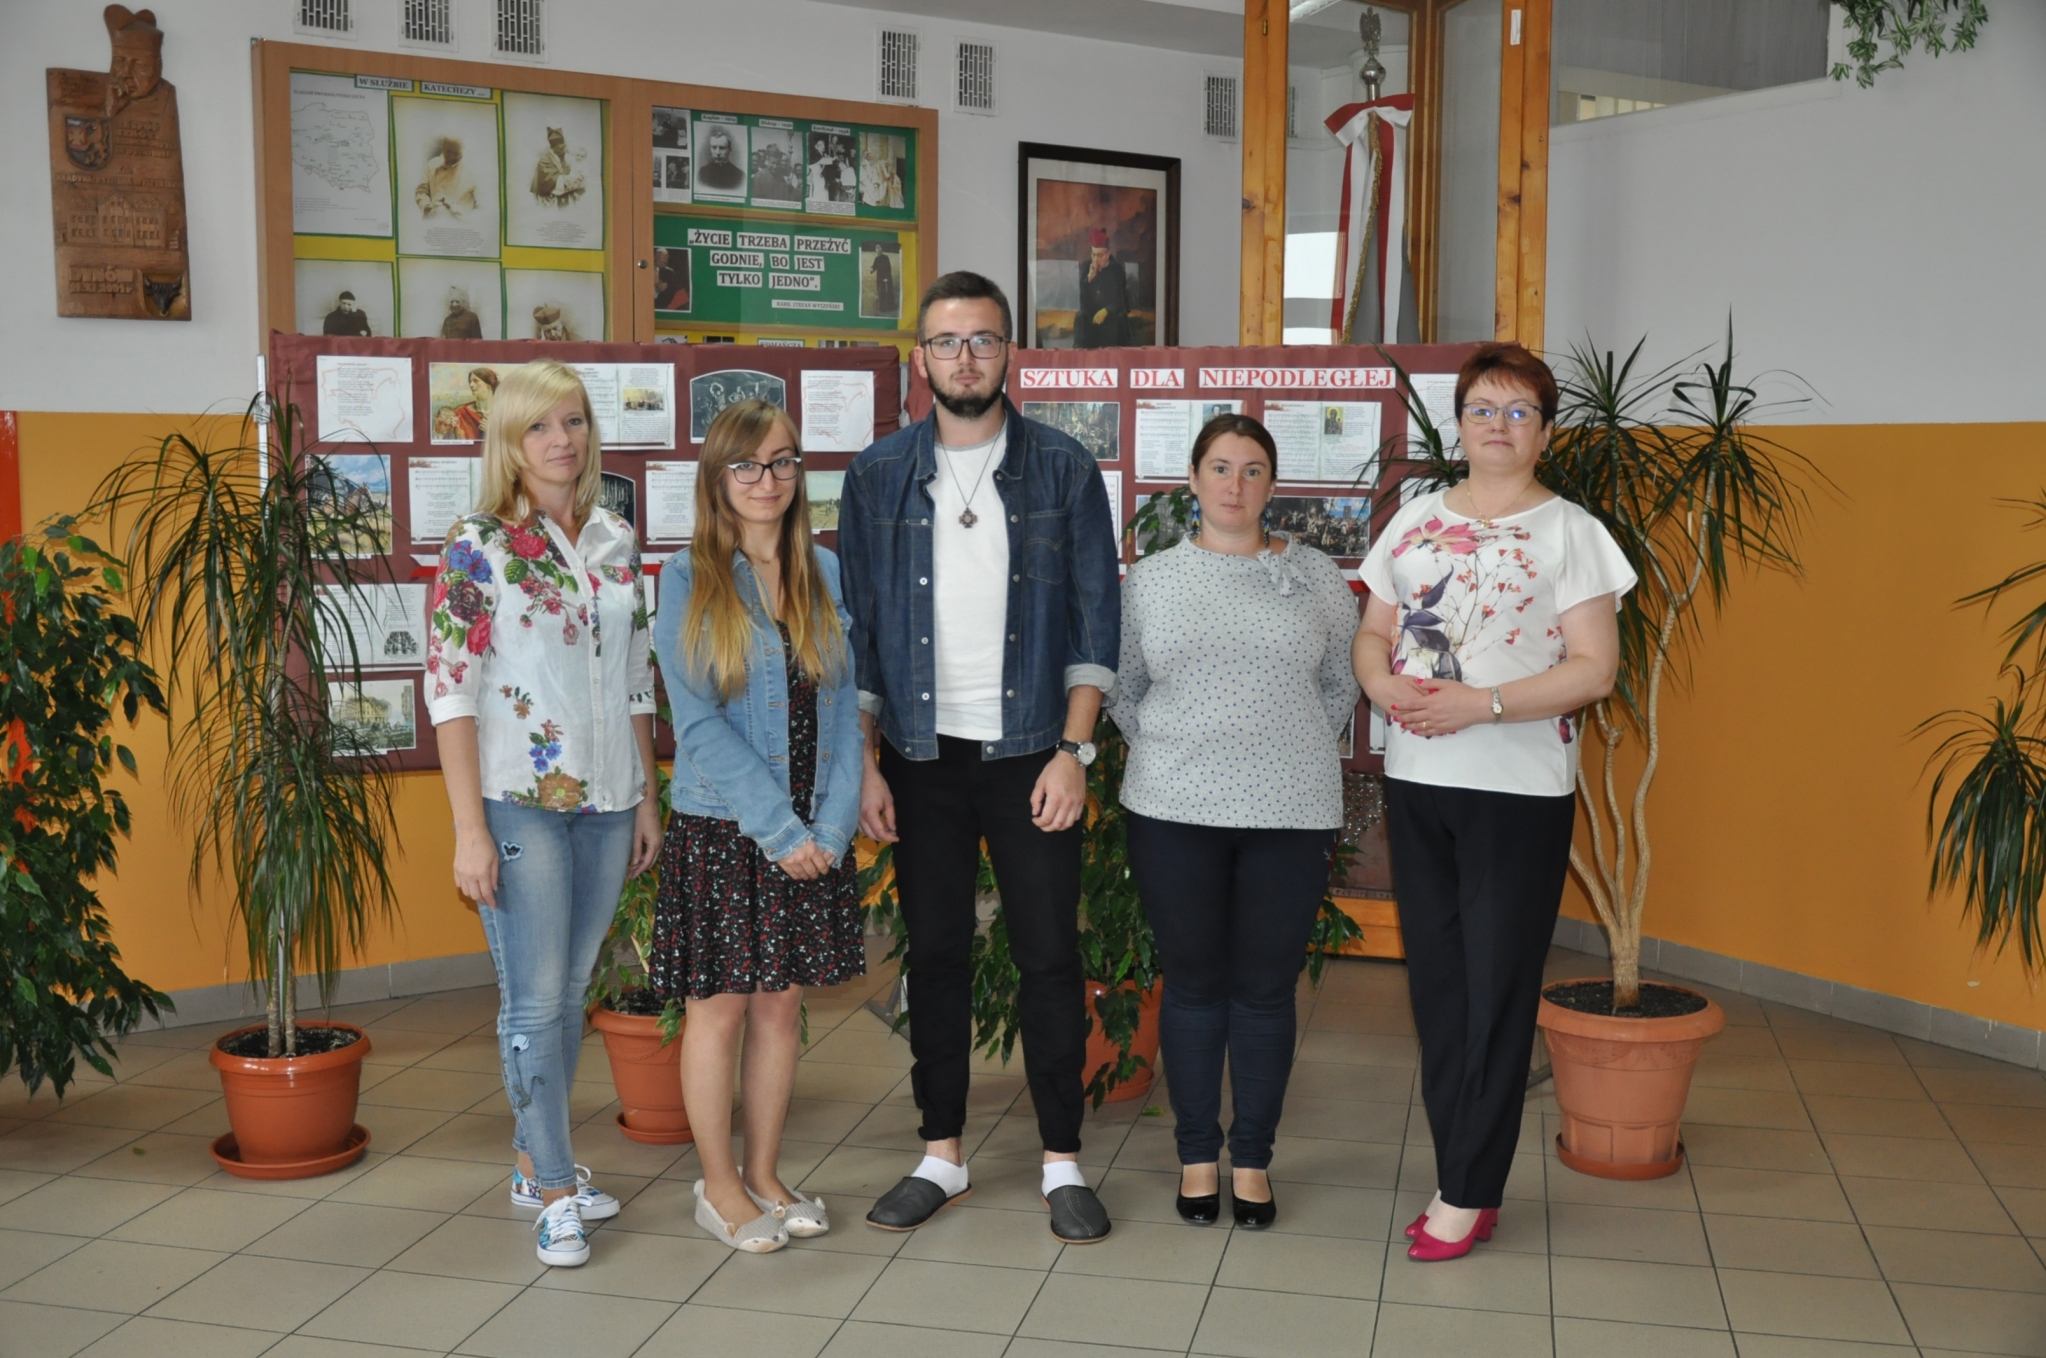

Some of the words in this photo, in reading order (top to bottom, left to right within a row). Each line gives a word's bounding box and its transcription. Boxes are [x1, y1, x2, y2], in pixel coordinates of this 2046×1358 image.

[358, 78, 369, 86] W
[370, 78, 409, 89] SŁUŻBIE
[423, 83, 476, 96] KATECHEZY
[689, 229, 730, 246] „ŻYCIE
[739, 234, 788, 249] TRZEBA
[796, 238, 849, 253] PRZEŻYĆ
[711, 252, 762, 267] GODNIE,
[771, 255, 788, 268] BO
[796, 257, 823, 270] JEST
[719, 272, 761, 286] TYLKO
[1022, 370, 1115, 387] SZTUKA
[1133, 370, 1181, 387] DLA
[1203, 369, 1395, 387] NIEPODLEGŁEJ
